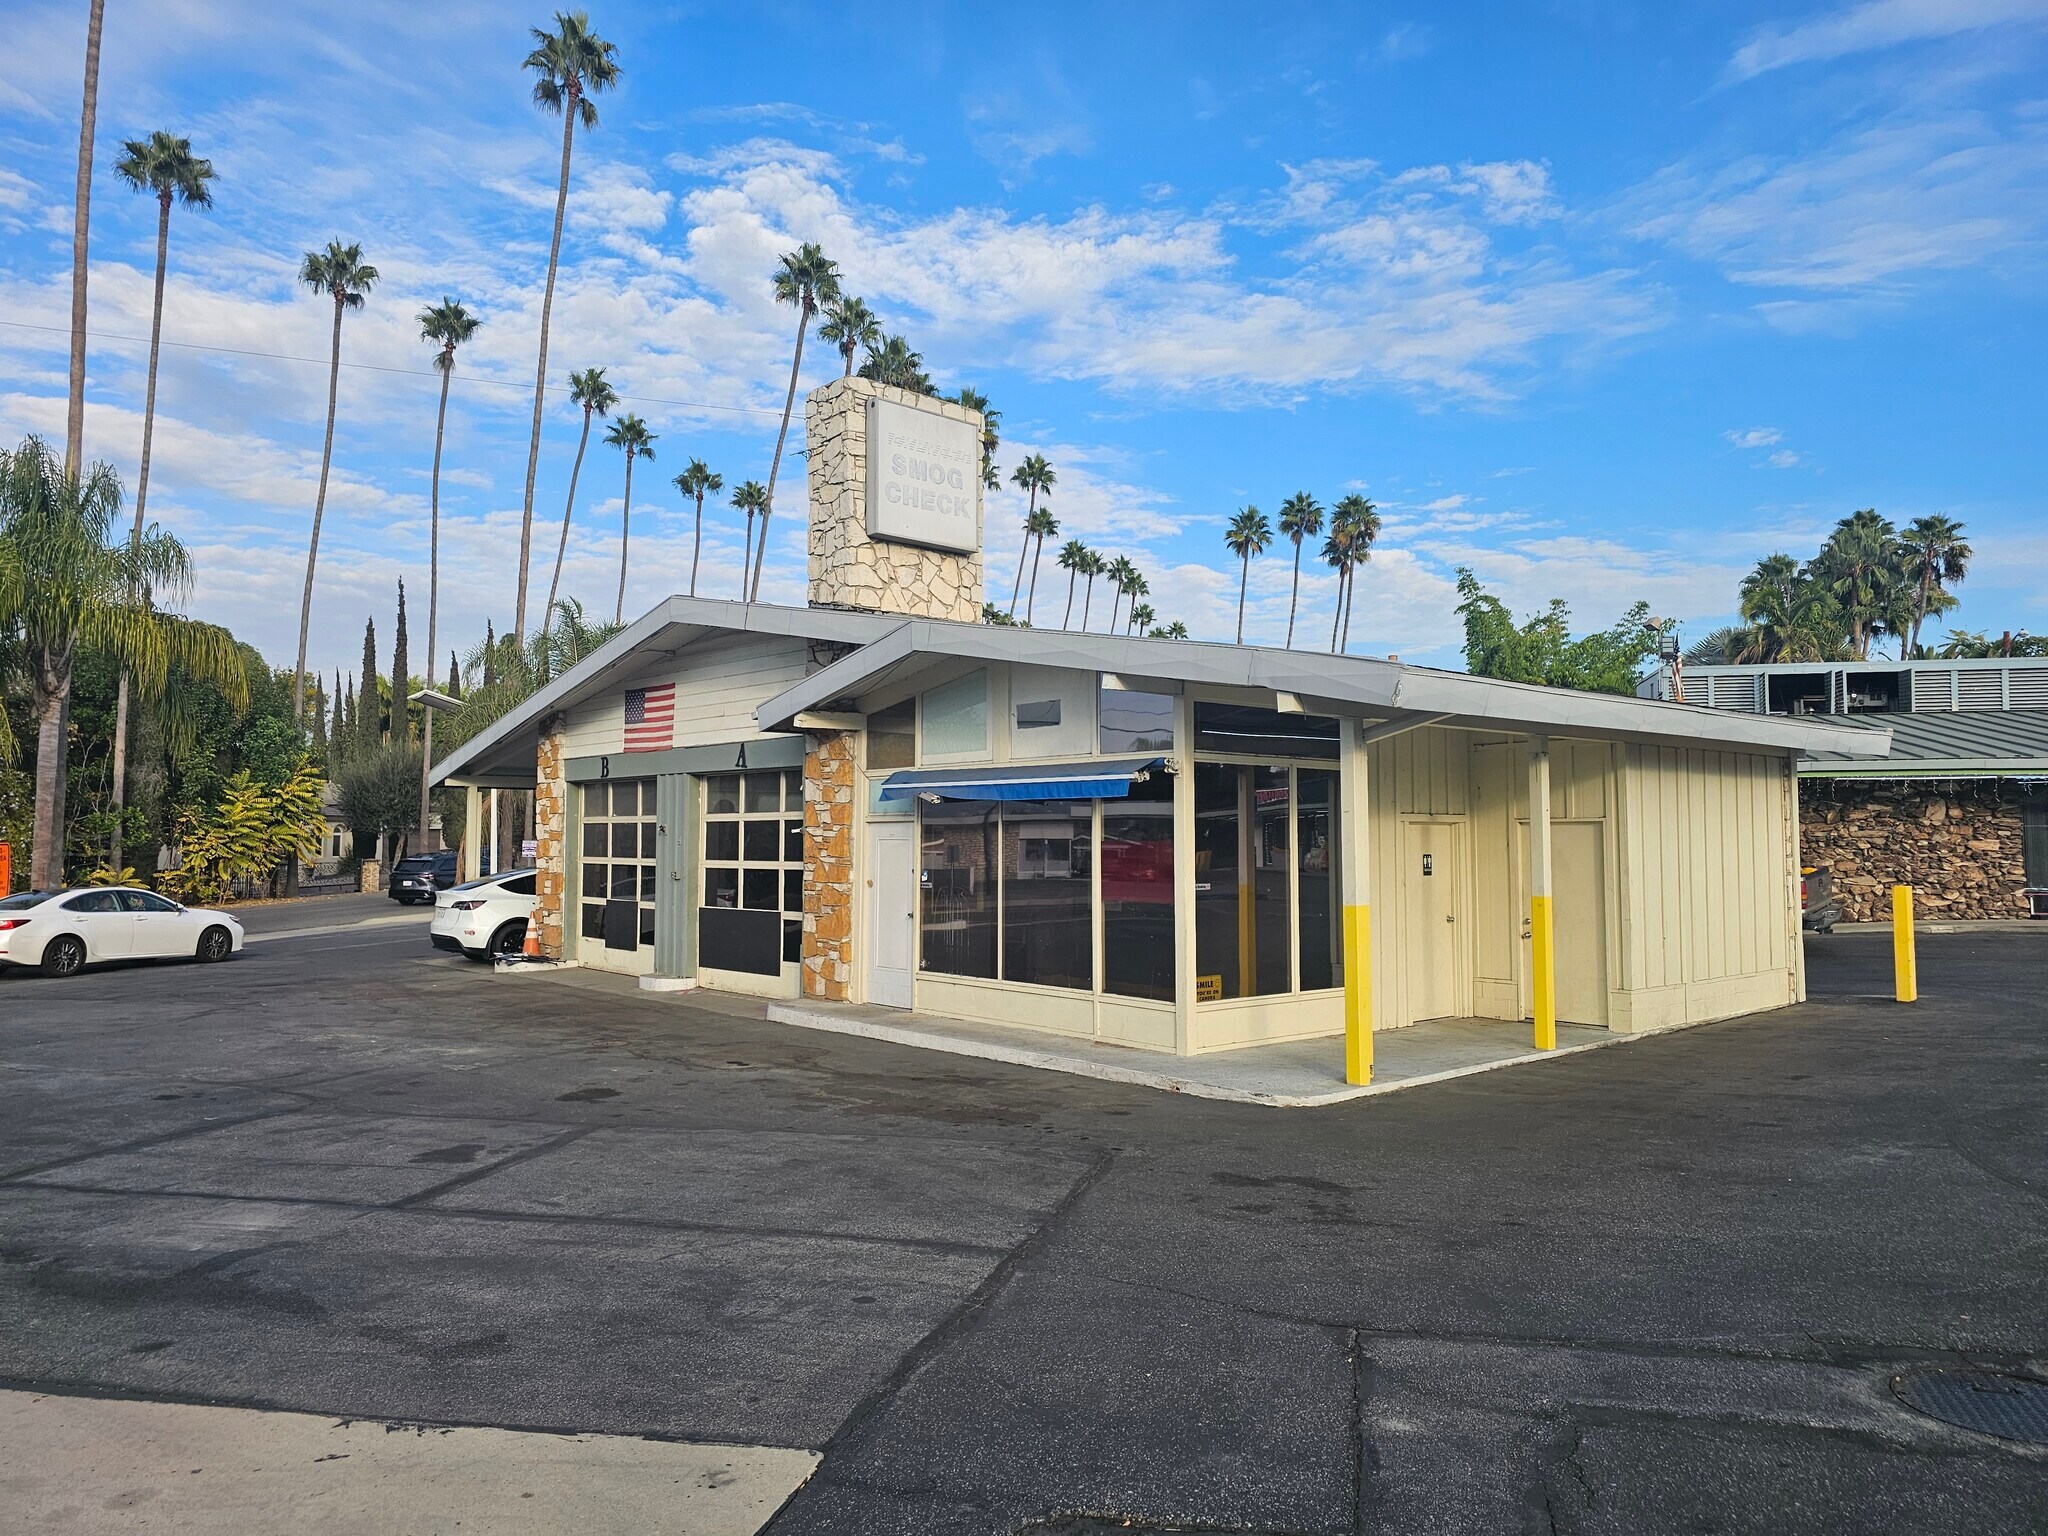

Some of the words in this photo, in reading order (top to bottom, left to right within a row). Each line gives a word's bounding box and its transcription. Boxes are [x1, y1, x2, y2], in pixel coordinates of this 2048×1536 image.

[891, 453, 963, 490] SMOG
[884, 481, 971, 520] CHECK
[600, 757, 609, 778] B
[735, 743, 748, 768] A
[1196, 981, 1214, 989] SMILE
